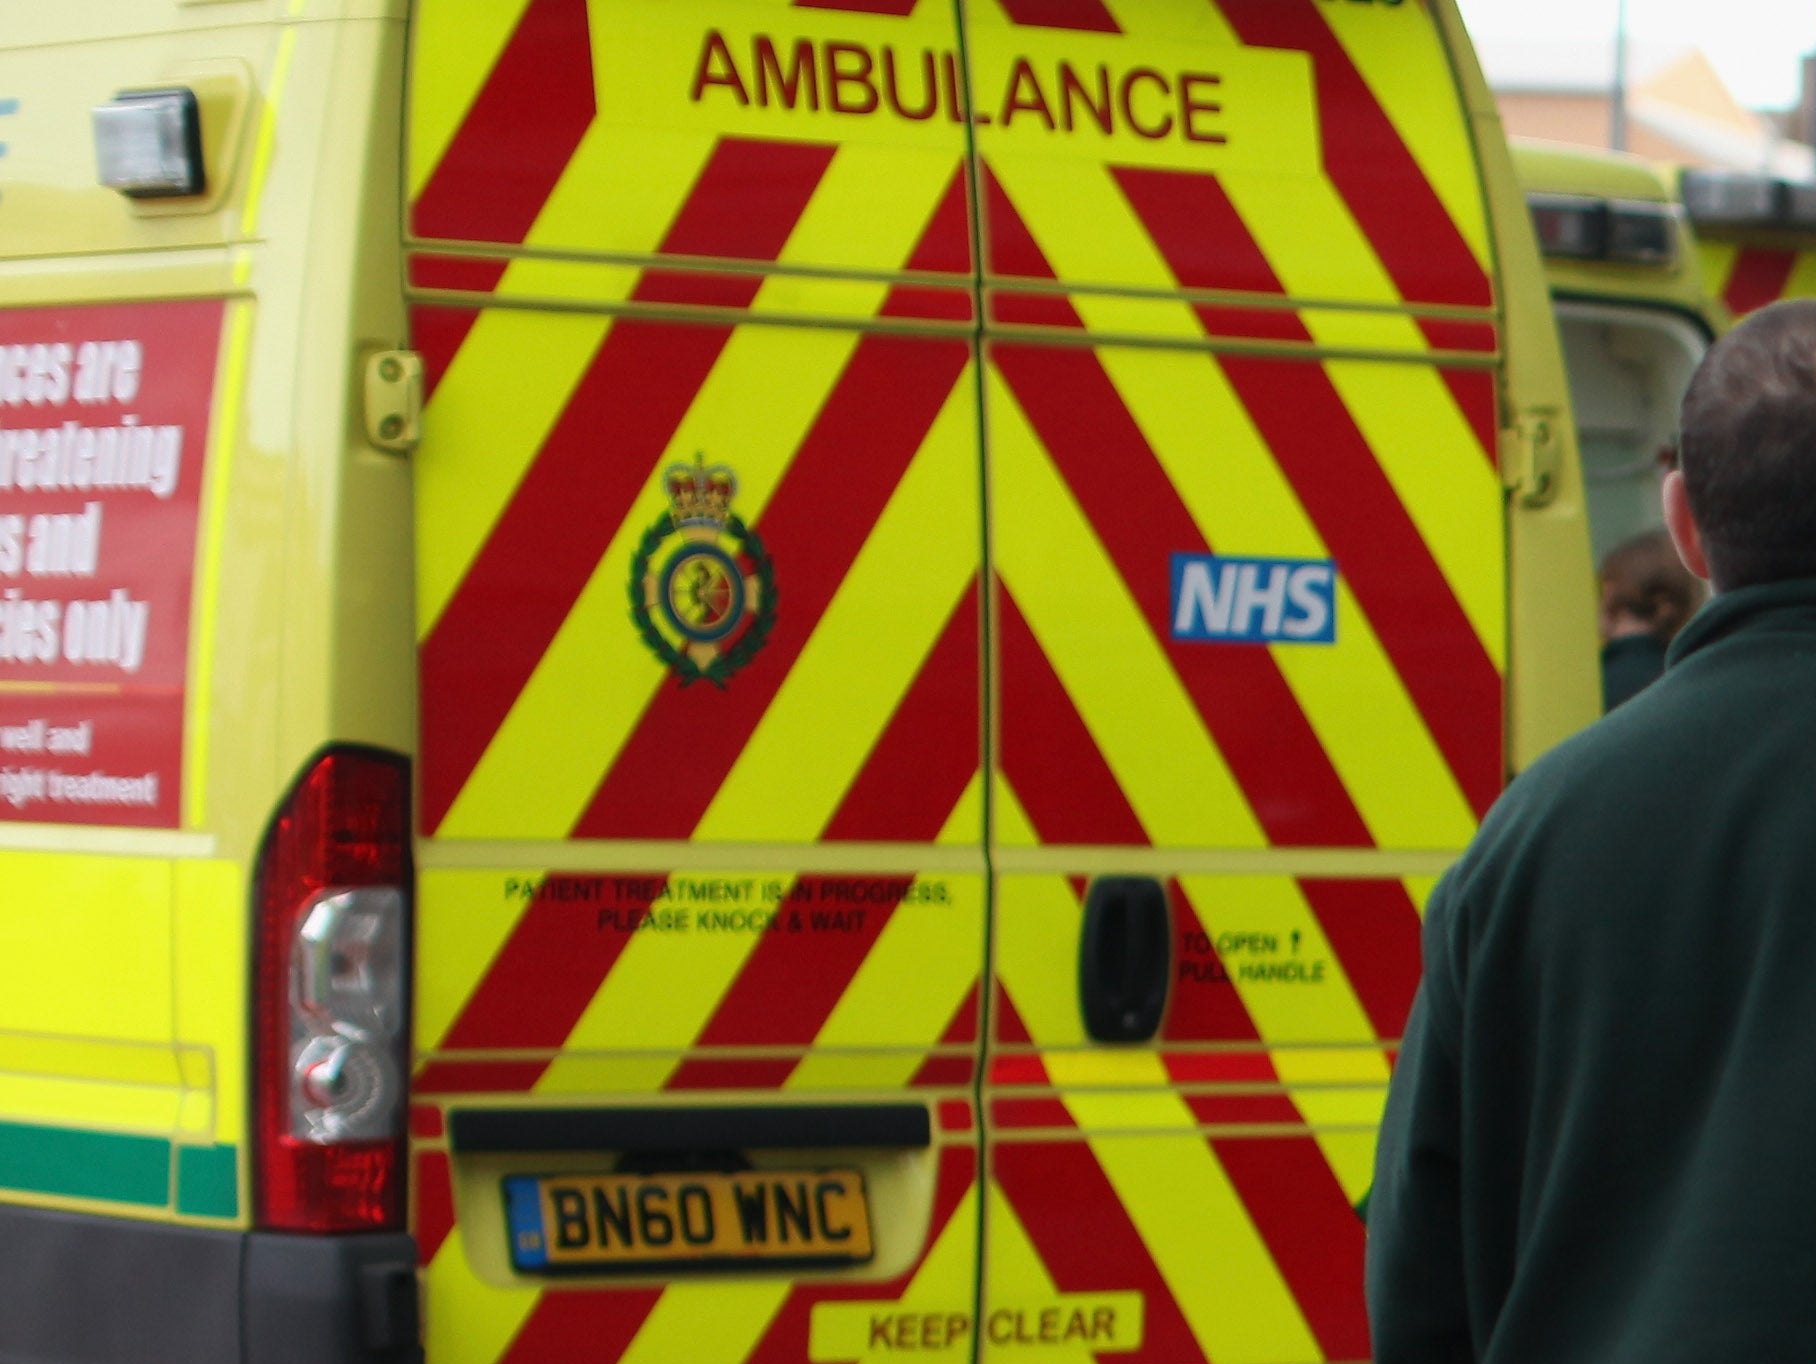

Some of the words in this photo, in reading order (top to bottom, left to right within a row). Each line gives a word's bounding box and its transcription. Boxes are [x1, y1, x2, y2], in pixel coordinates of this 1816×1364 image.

[690, 29, 1227, 144] AMBULANCE
[0, 341, 74, 408] ces
[73, 338, 144, 406] are
[27, 500, 104, 578] and
[1173, 560, 1331, 637] NHS
[63, 587, 149, 675] only
[46, 718, 94, 758] and
[47, 768, 160, 808] treatment
[504, 877, 602, 902] PATIENT
[613, 878, 753, 903] TREATMENT
[760, 879, 784, 902] IS
[598, 908, 689, 932] PLEASE
[695, 909, 781, 933] KNOCK
[787, 910, 804, 933] &
[810, 911, 867, 933] WAIT
[1183, 931, 1212, 955] TO
[1217, 931, 1278, 955] OPEN
[1179, 960, 1231, 983] PULL
[1237, 960, 1326, 983] HANDLE
[550, 1183, 717, 1250] BN60
[733, 1178, 853, 1244] WNC
[868, 1312, 969, 1350] KEEP
[987, 1305, 1117, 1345] CLEAR
